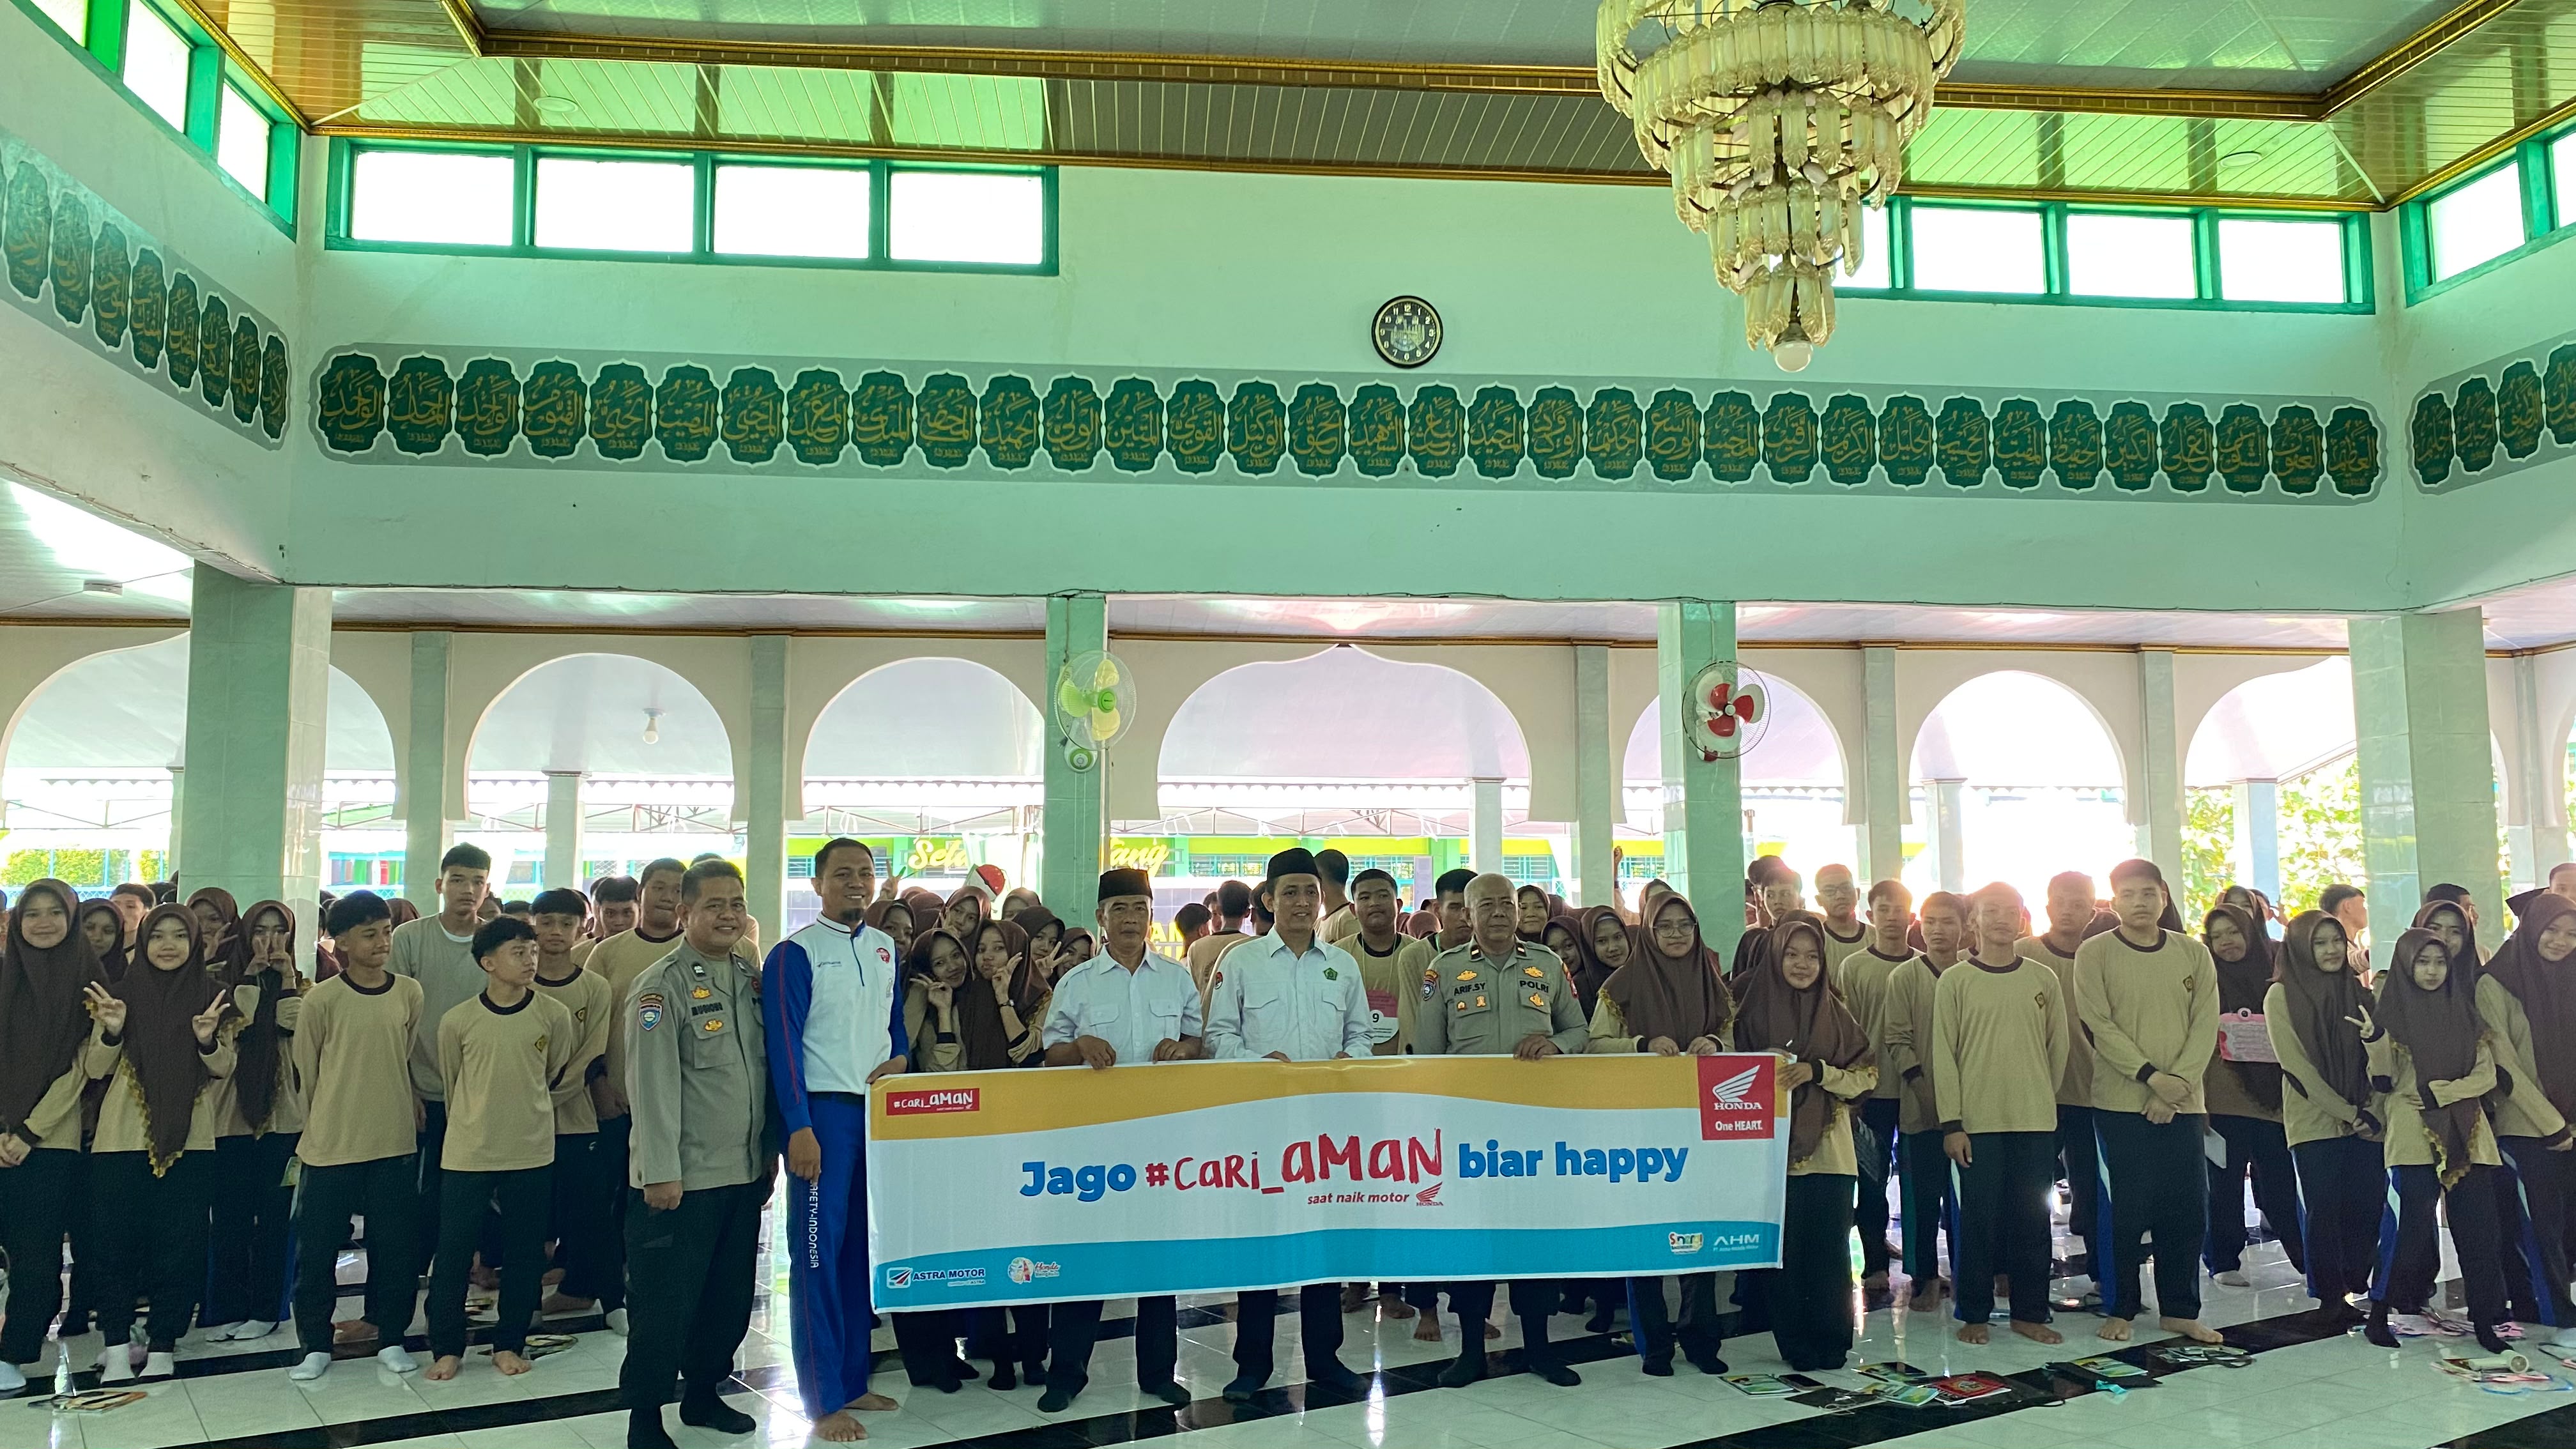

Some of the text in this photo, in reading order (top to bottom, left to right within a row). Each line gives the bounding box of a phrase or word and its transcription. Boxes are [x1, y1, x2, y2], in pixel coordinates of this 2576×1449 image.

[1519, 980, 1549, 993] POLRI
[1372, 1013, 1379, 1023] 9
[1713, 1102, 1763, 1110] HONDA
[1715, 1121, 1733, 1131] One
[1020, 1161, 1137, 1202] Jago
[1459, 1139, 1544, 1179] biar
[1555, 1141, 1689, 1183] happy
[1307, 1192, 1410, 1204] saat naik motor
[808, 1181, 820, 1269] AFETY-INDONESIA
[1713, 1234, 1759, 1246] AHM
[912, 1269, 985, 1281] ASTRA MOTOR
